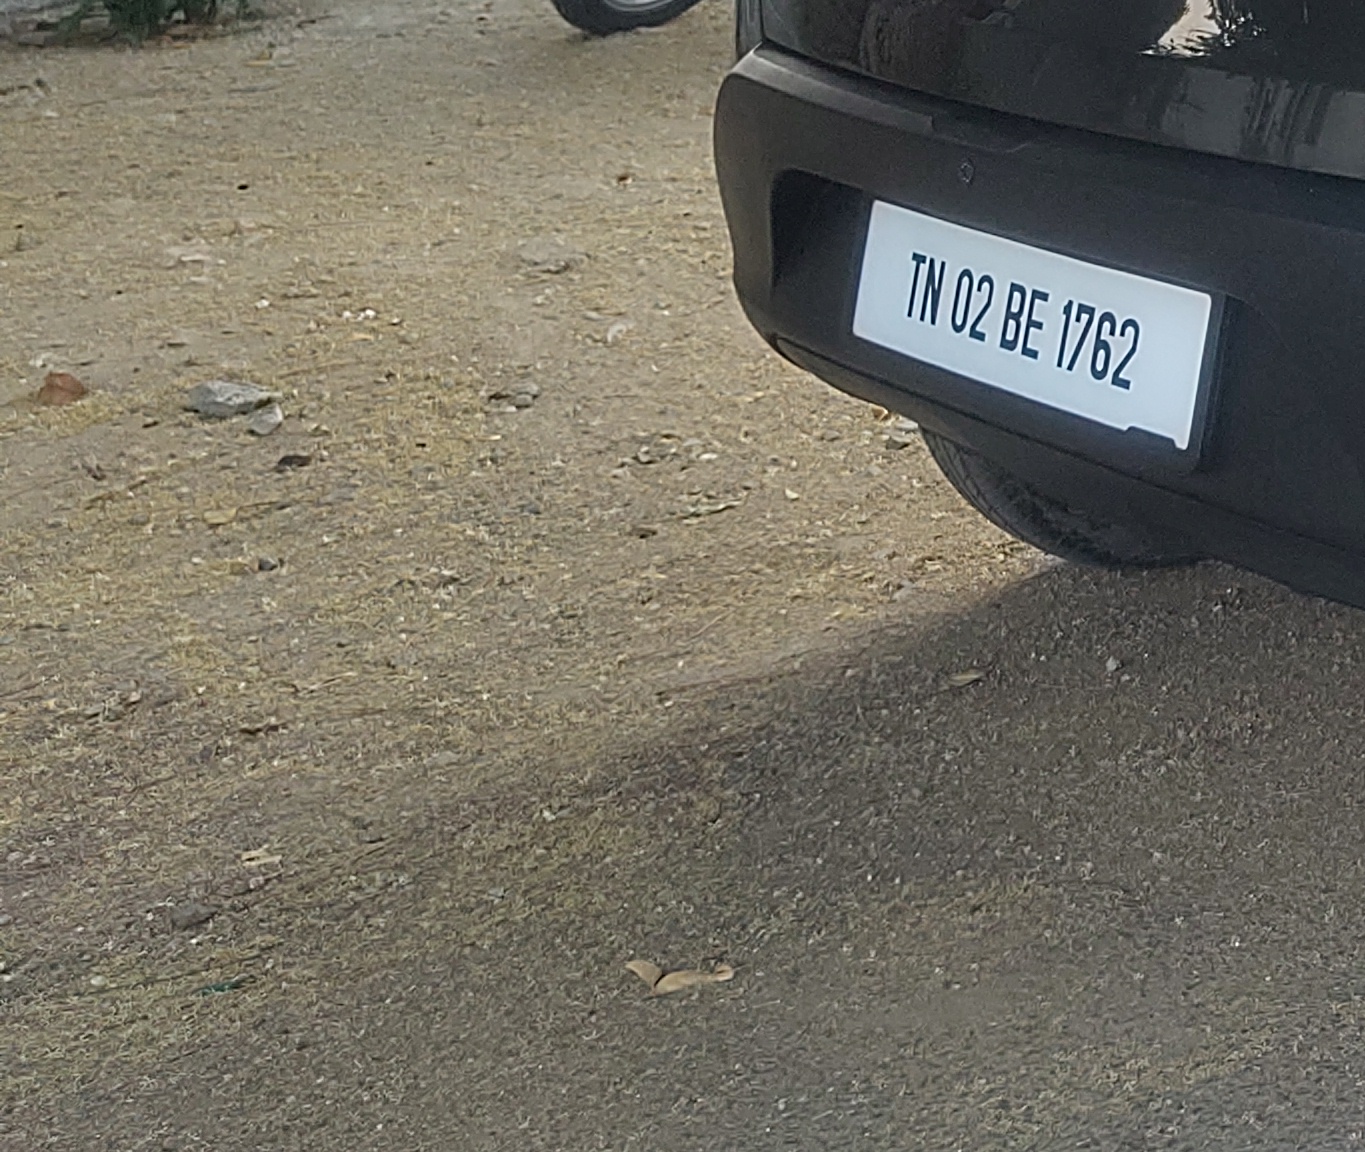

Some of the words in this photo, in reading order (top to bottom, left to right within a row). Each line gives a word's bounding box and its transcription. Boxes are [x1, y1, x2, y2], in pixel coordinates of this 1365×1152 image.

[906, 251, 947, 326] TN
[951, 268, 995, 343] 02
[1000, 282, 1050, 361] BE
[1056, 298, 1141, 391] 1762
